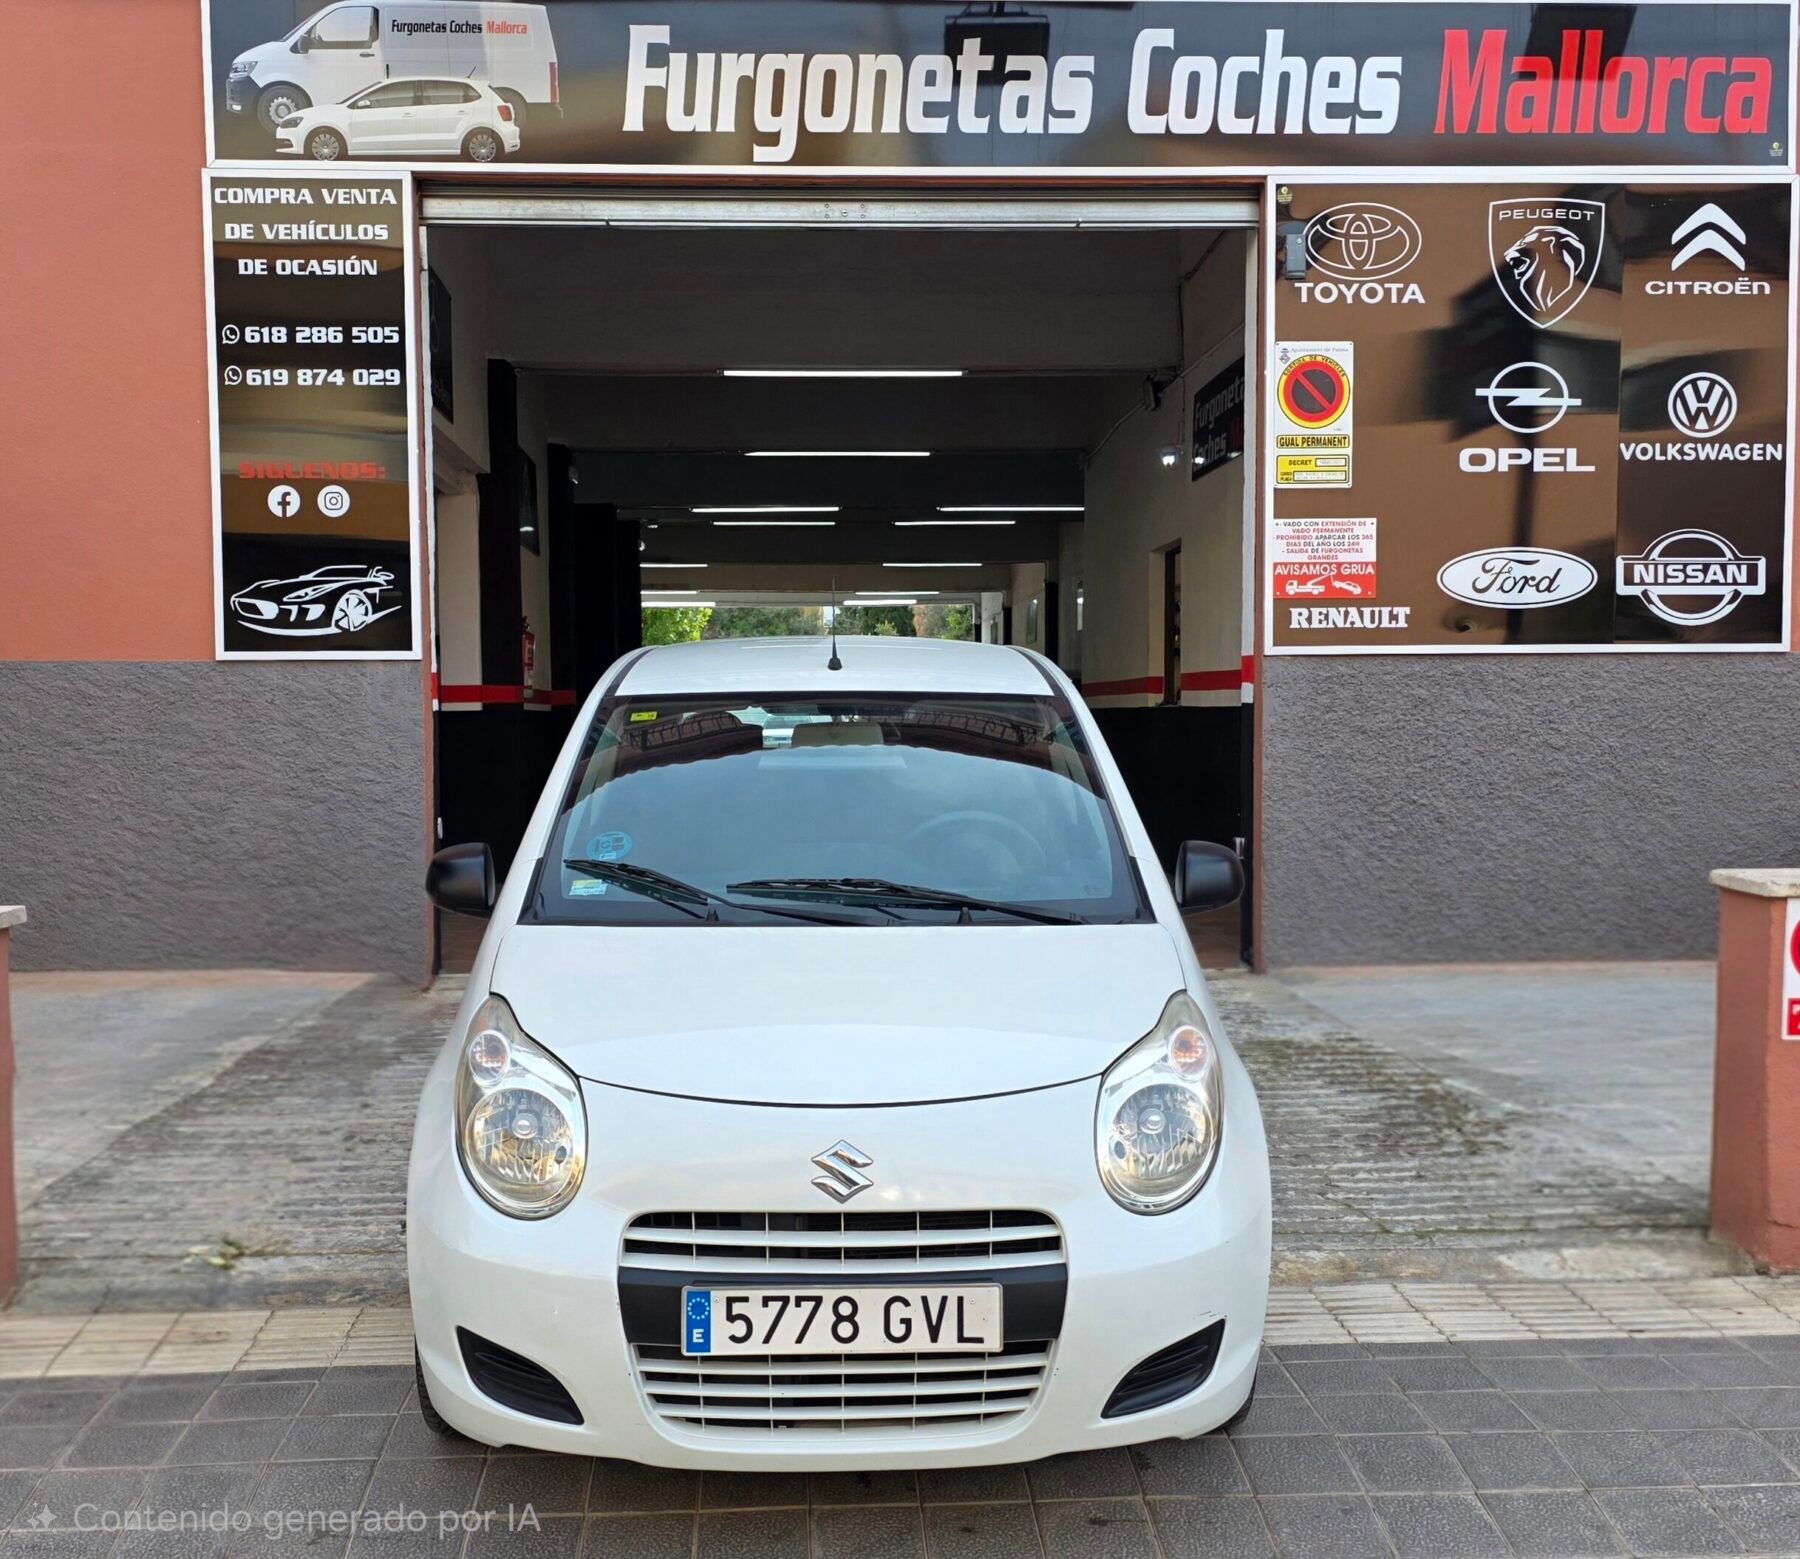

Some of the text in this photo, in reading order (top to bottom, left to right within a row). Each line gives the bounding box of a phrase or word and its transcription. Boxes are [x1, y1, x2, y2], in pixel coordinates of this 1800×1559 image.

[391, 19, 528, 36] Furgonetas Coches Mallorca
[622, 24, 1773, 163] Furgonetas Coches Mallorca
[214, 187, 397, 205] COMPRA VENTA
[1498, 208, 1595, 222] PEUGEOT
[224, 220, 389, 241] DE VEHÍCULOS
[238, 255, 378, 276] DE OCASIÓN
[1293, 282, 1425, 304] TOYOTA
[244, 326, 400, 344] 618 286 505
[246, 368, 401, 387] 619 874 029
[1279, 436, 1347, 447] GUAL PERMANENT
[1459, 447, 1595, 473] OPEL
[1619, 443, 1783, 463] VOLKSWAGEN
[1321, 519, 1357, 527] EXTENSIÓN
[1274, 563, 1375, 576] AVISAMOS GRUA
[1471, 557, 1562, 595] Ford
[1633, 564, 1748, 584] NISSAN
[1289, 606, 1411, 629] RENAULT
[692, 1295, 985, 1345] E 5778 GVL
